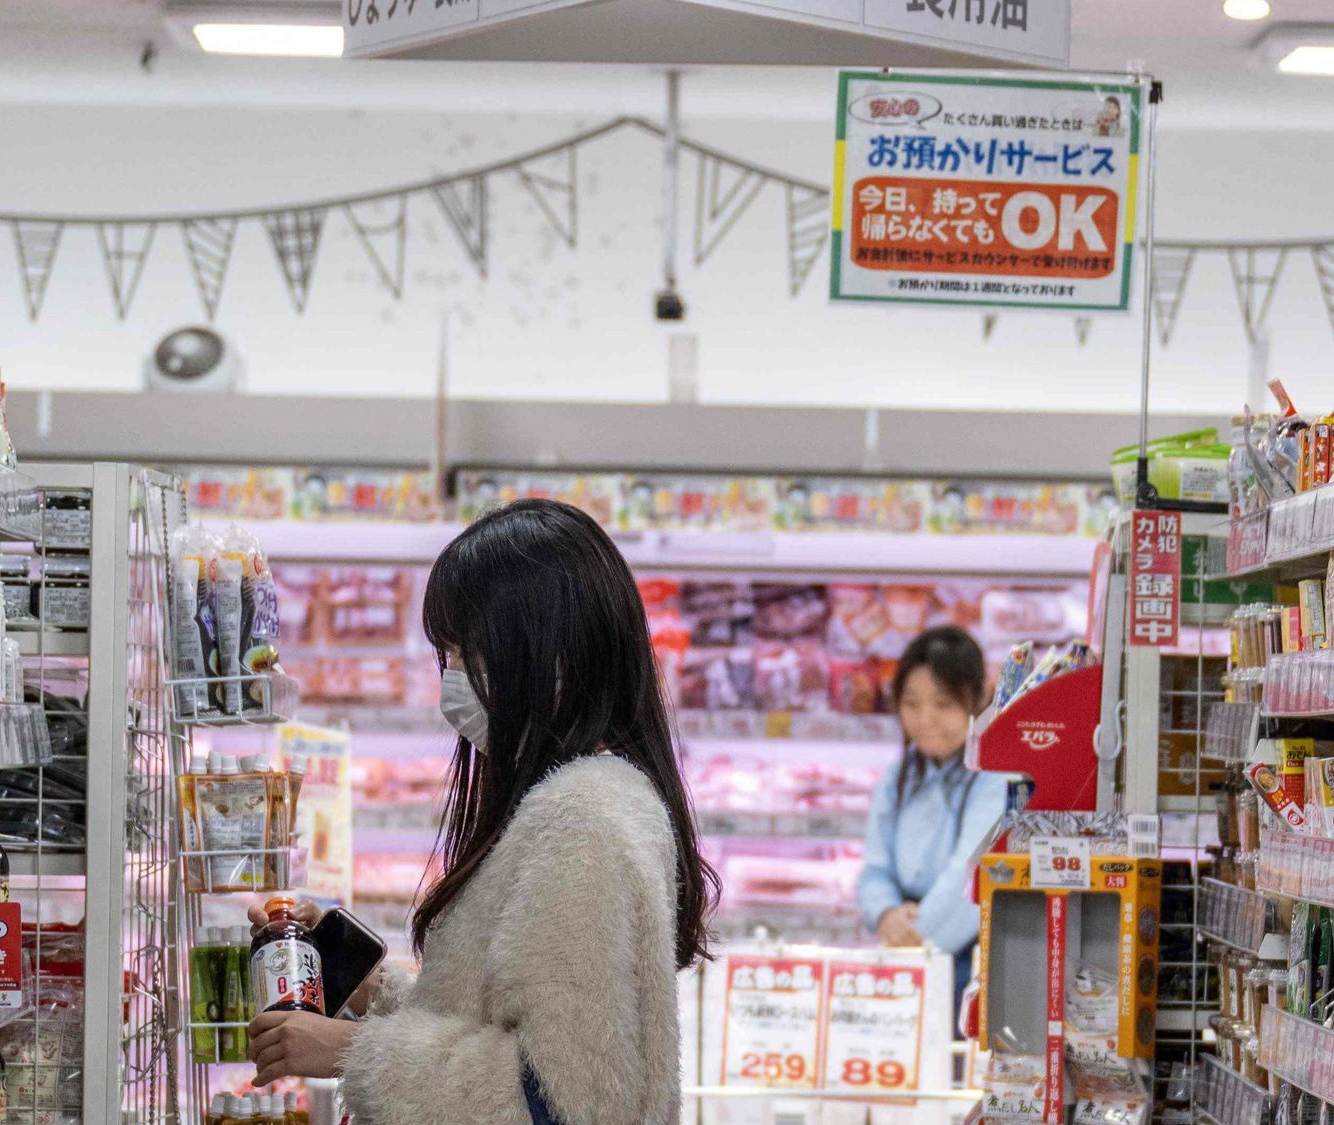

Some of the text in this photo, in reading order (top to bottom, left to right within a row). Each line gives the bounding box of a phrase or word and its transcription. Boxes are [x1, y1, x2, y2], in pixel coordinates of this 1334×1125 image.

[867, 134, 1116, 177] お預かりサービス
[861, 214, 995, 245] 帰らなくても
[1001, 190, 1109, 253] OK
[1135, 516, 1155, 570] カメラ
[1157, 513, 1179, 554] 防犯
[1133, 573, 1174, 644] 録画中
[1021, 729, 1061, 747] エバラ
[1052, 855, 1082, 872] 98
[732, 964, 817, 991] 広告の品
[832, 970, 918, 998] 広告の品
[739, 1052, 807, 1081] 259
[841, 1057, 908, 1088] 89
